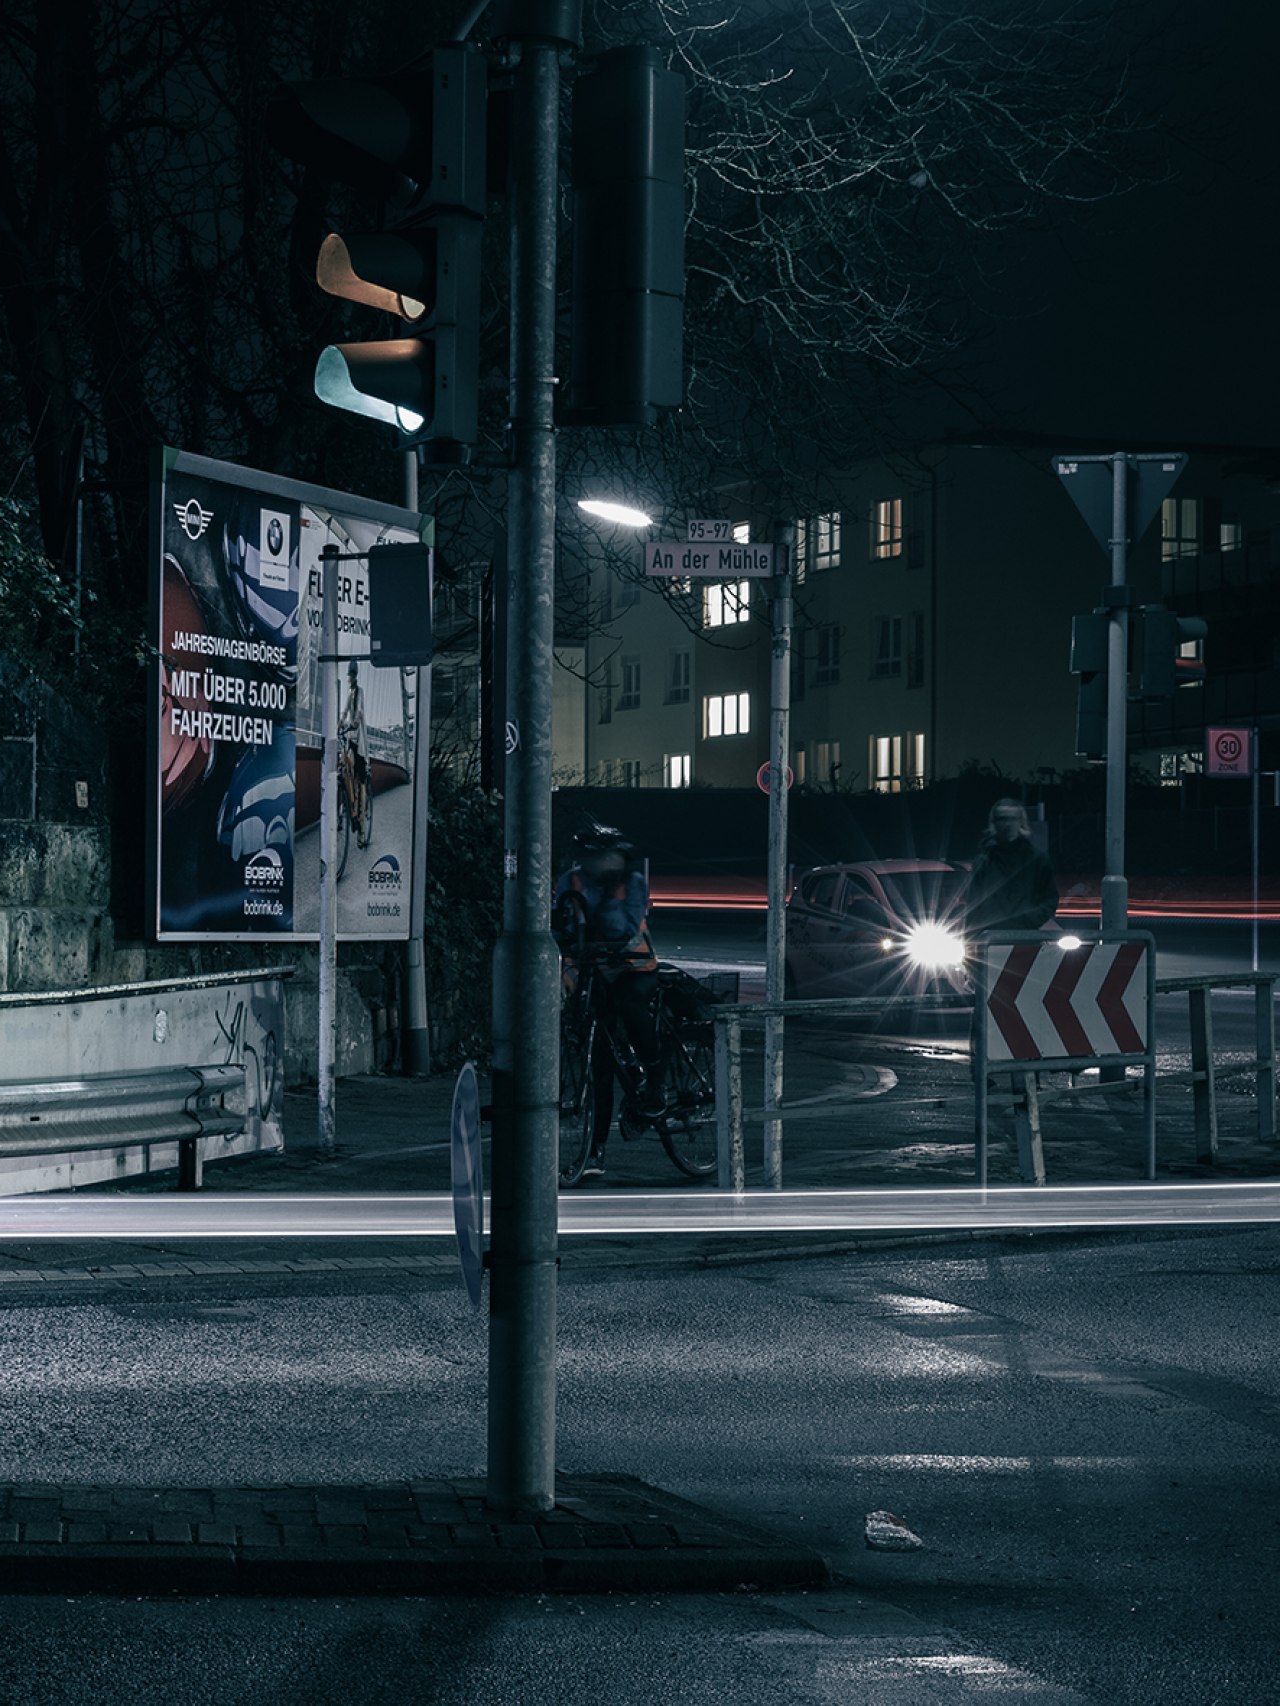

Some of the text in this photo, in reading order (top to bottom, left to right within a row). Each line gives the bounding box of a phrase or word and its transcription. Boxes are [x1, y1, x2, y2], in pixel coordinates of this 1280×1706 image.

[690, 522, 729, 539] 95-97
[652, 549, 768, 569] An der Mühle
[171, 630, 287, 667] JAHRESWAGENBÖRSE
[171, 666, 287, 710] MIT ÜBER 5.000
[171, 707, 273, 746] FAHRZEUGEN
[1220, 740, 1238, 755] 30
[1218, 763, 1239, 771] ZONE
[244, 899, 284, 916] bobrink.de
